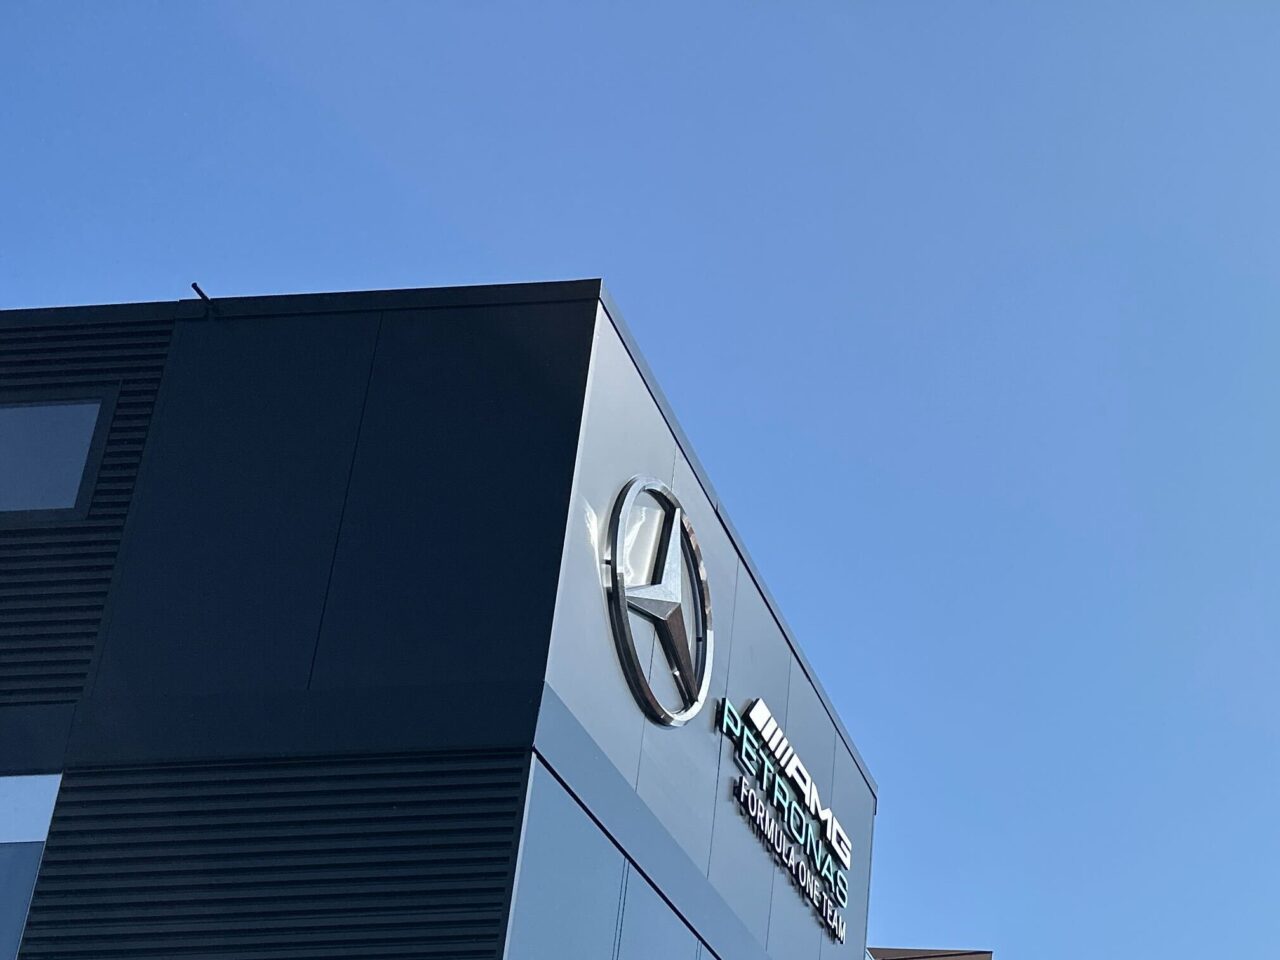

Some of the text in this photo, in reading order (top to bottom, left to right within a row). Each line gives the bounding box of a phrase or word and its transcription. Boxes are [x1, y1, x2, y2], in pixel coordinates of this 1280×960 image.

[722, 698, 849, 909] PETRONAS
[740, 775, 847, 943] FORMULA ONE TEAM
[785, 753, 852, 871] AMG
